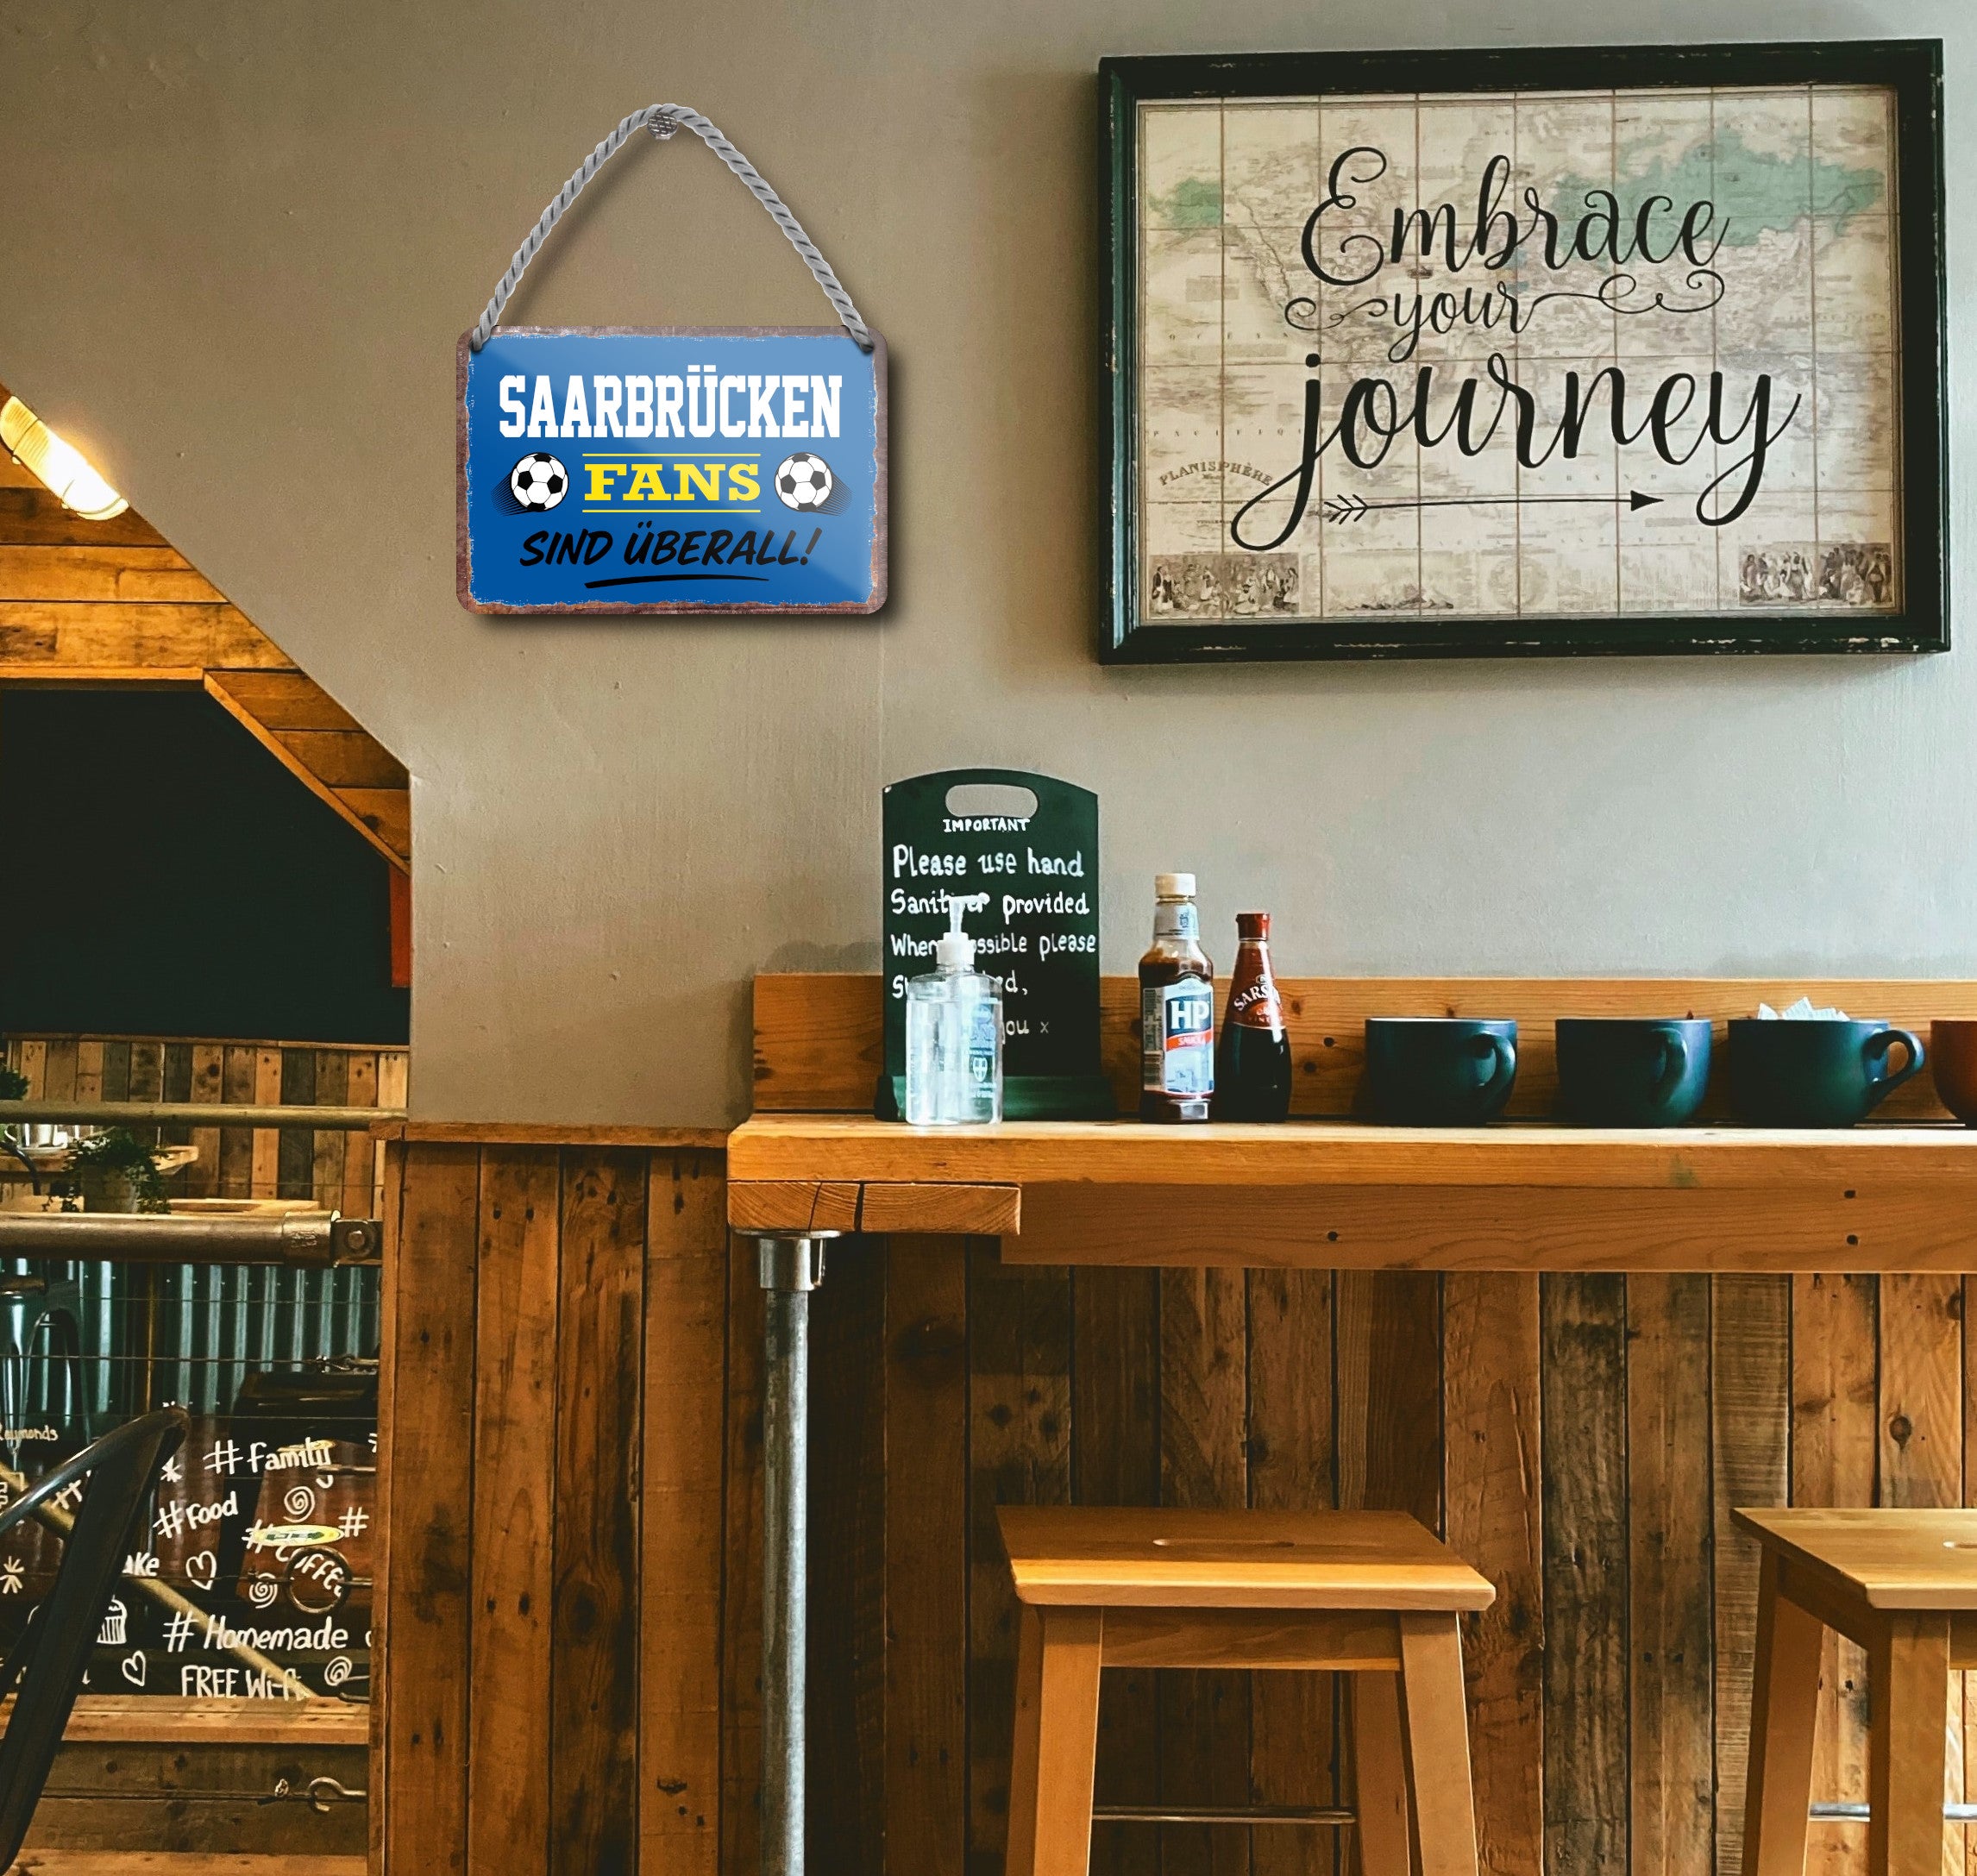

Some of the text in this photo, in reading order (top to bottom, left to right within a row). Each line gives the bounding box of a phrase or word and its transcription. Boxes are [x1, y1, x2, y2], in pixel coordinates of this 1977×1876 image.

[1302, 146, 1729, 285] Embrace
[499, 364, 843, 438] SAARBRÜCKEN
[1232, 353, 1802, 550] journey
[584, 462, 761, 502] FANS
[1158, 461, 1273, 486] PLANISPHÈRE
[519, 521, 823, 567] SIND ÜBERALL!
[943, 817, 1031, 833] IMPORTANT
[893, 844, 1085, 878] Please use hand
[1002, 891, 1090, 925] provided
[1039, 932, 1096, 962] please
[1170, 1001, 1209, 1030] HP
[181, 1665, 240, 1698] FREE
